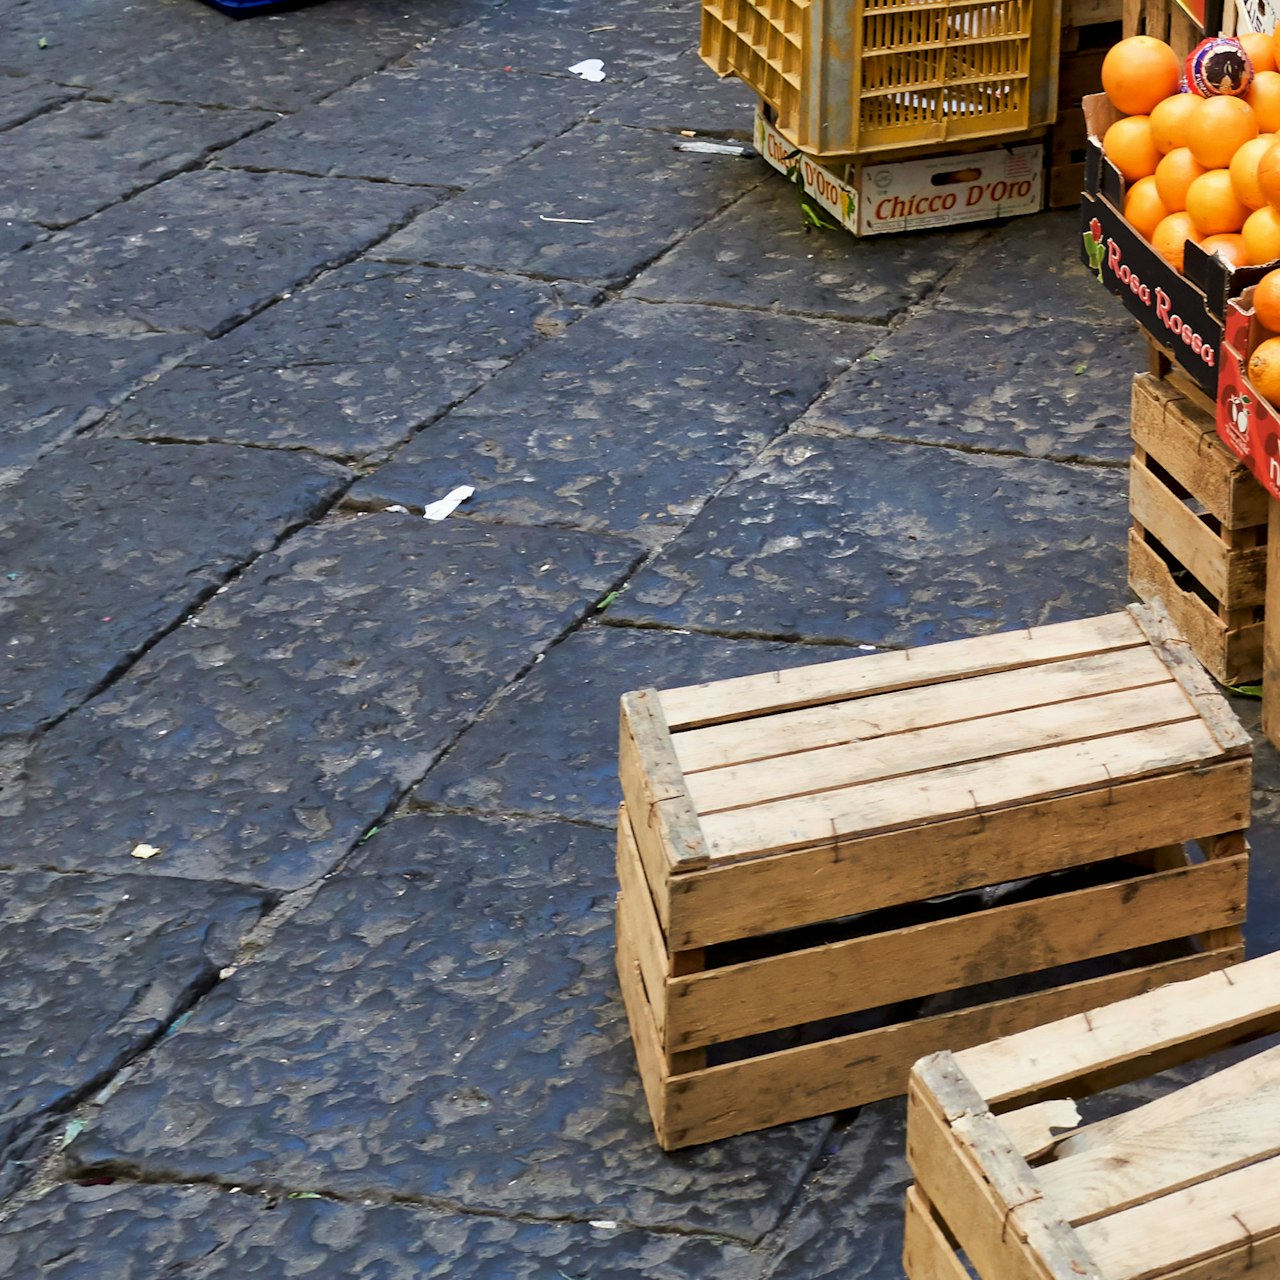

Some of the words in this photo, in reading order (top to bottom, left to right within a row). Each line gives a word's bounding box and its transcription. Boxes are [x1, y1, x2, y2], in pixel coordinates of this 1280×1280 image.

[876, 196, 956, 220] Chicco
[964, 178, 1033, 208] D'Oro
[1106, 237, 1152, 306] Rosa
[1154, 286, 1215, 368] Rossa
